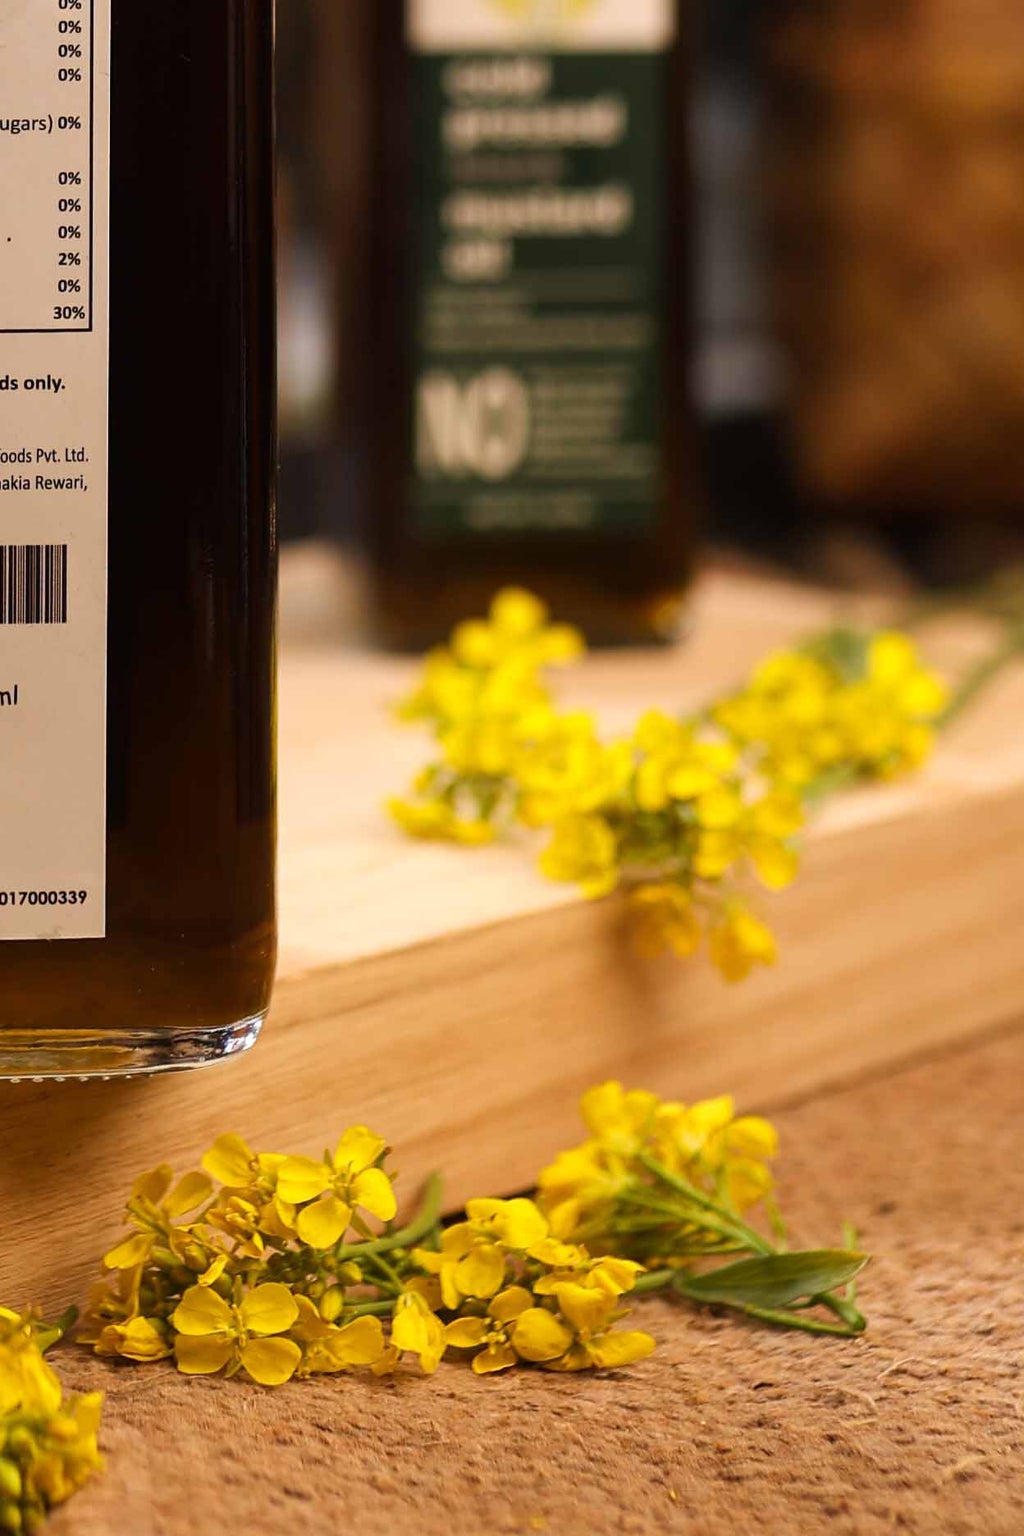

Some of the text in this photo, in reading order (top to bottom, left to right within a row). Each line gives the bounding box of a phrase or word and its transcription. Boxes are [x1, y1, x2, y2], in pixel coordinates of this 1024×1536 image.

[57, 19, 83, 35] 0%
[57, 43, 83, 59] 0%
[57, 67, 82, 83] 0%
[57, 115, 82, 130] 0%
[57, 170, 82, 186] 0%
[57, 197, 82, 213] 0%
[57, 224, 82, 240] 0%
[57, 251, 82, 267] 2%
[57, 278, 82, 294] 0%
[52, 305, 86, 320] 30%
[23, 373, 66, 394] only.
[36, 447, 61, 464] Pvt.
[64, 446, 89, 463] Ltd.
[35, 474, 88, 492] Rewari,
